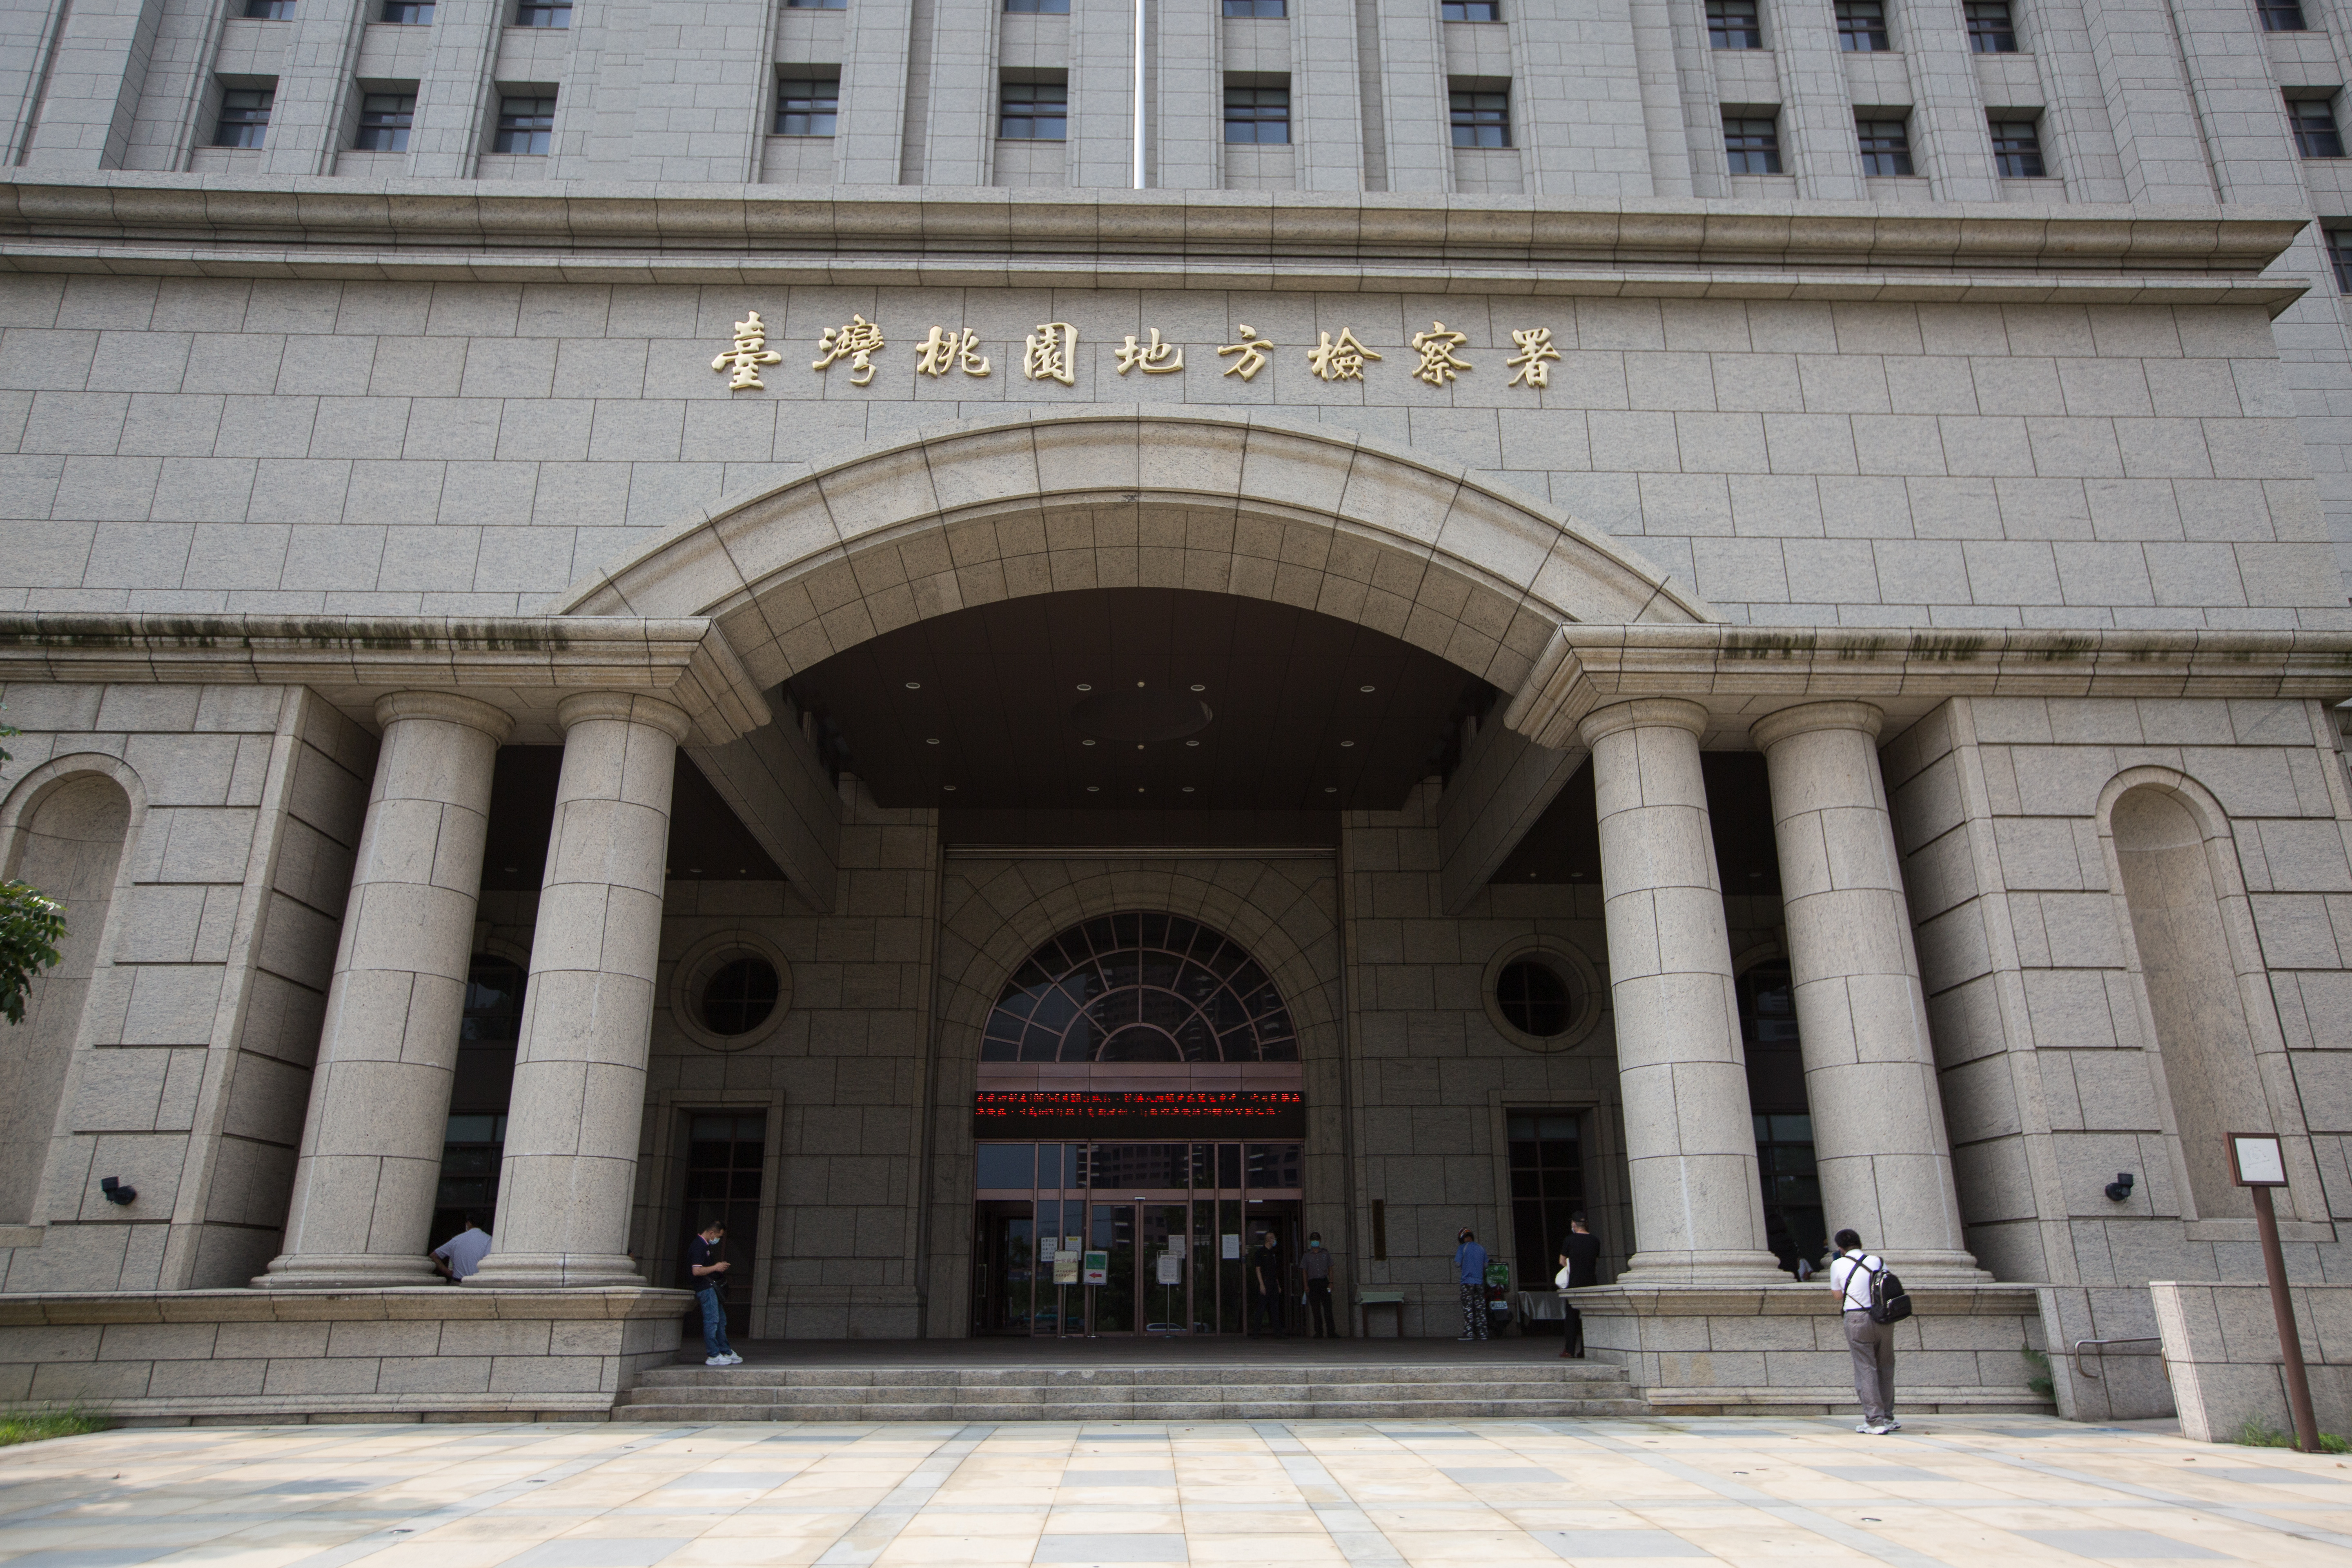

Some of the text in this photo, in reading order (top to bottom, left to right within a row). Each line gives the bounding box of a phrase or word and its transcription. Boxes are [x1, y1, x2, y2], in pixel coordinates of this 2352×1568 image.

[711, 310, 1561, 389] 臺灣桃園地方檢察署
